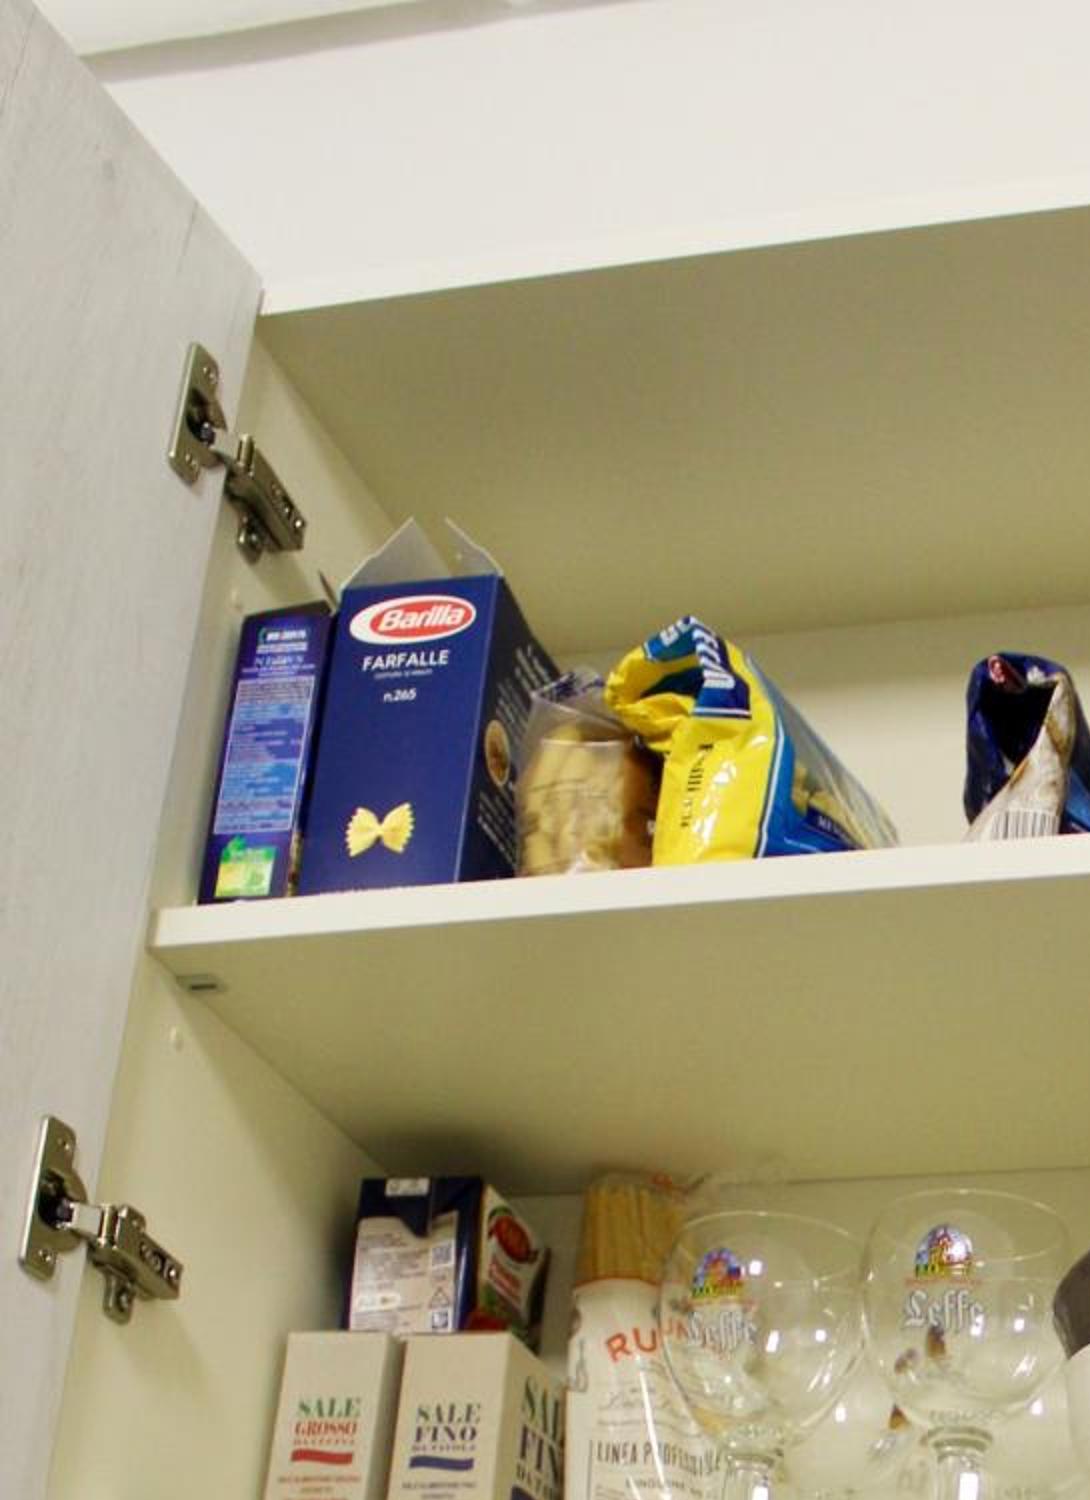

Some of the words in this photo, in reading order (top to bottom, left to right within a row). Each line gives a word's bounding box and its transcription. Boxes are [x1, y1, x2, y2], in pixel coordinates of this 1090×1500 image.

[378, 603, 466, 631] Barilla
[361, 649, 449, 671] FARFALLE
[903, 1289, 986, 1337] Leffe
[297, 1396, 362, 1418] SALE
[416, 1402, 482, 1423] SALE
[520, 1376, 562, 1441] SAL
[293, 1420, 358, 1438] GROSSO
[414, 1425, 478, 1442] FINO
[519, 1423, 562, 1485] FIN
[596, 1440, 638, 1465] LINEA
